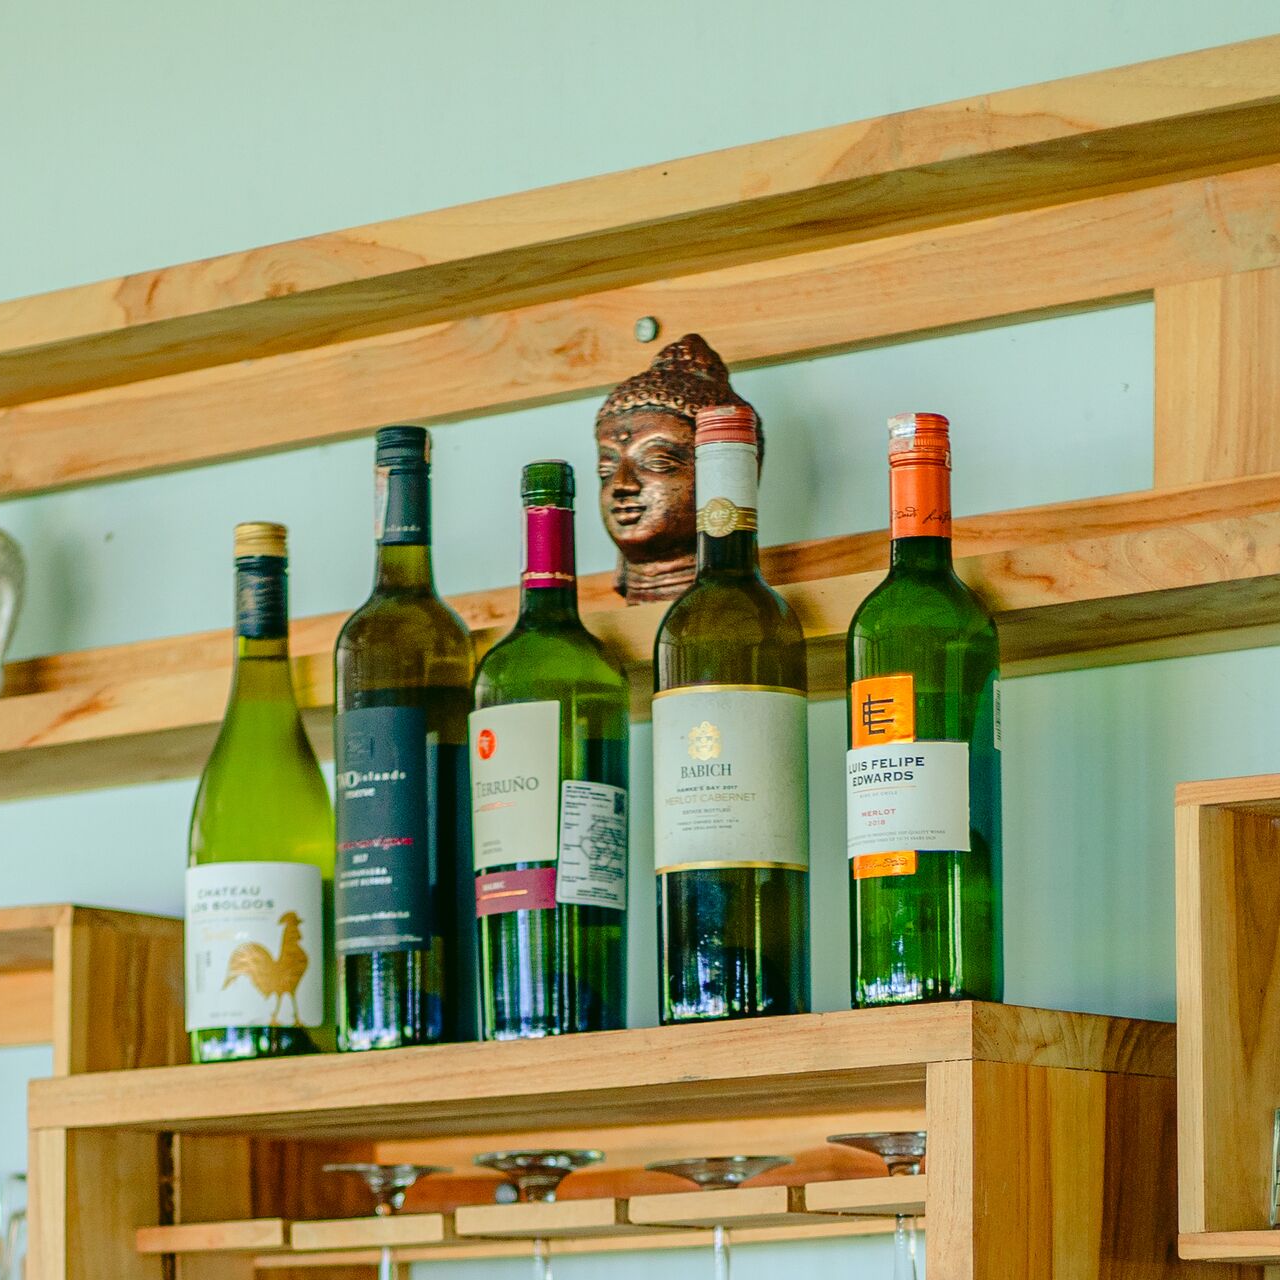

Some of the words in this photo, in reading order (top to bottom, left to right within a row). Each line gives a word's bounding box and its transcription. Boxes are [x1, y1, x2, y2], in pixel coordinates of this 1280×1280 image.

[680, 763, 732, 779] BABICH
[848, 761, 868, 775] LUIS
[871, 756, 926, 770] FELIPE
[475, 775, 540, 799] TERRUÑO
[852, 770, 915, 788] EDWARDS
[699, 792, 757, 802] CABERNET
[861, 808, 897, 818] MERLOT
[197, 885, 261, 899] CHATEAU
